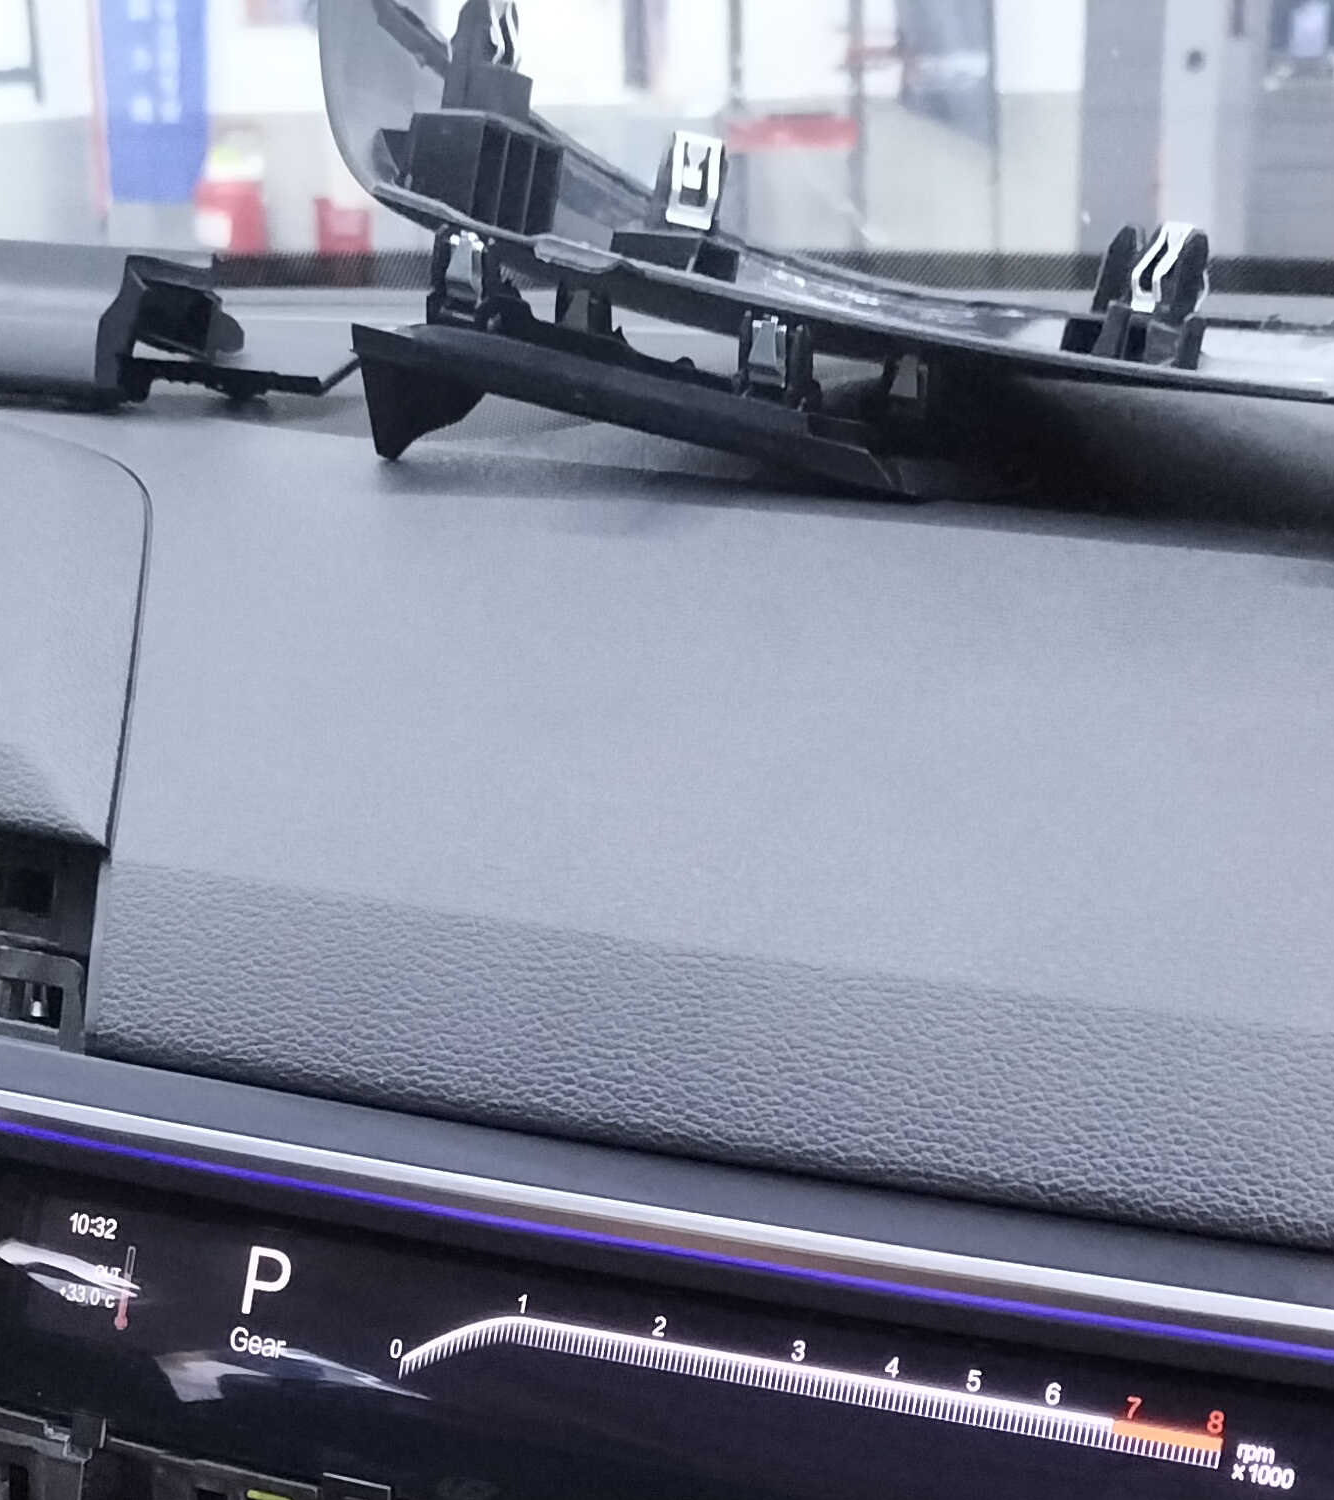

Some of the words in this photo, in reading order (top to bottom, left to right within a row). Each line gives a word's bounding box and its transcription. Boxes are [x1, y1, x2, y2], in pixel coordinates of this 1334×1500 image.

[69, 1212, 117, 1240] 10:32
[241, 1245, 292, 1315] P
[230, 1326, 287, 1359] Gear
[389, 1338, 403, 1359] 0
[518, 1294, 527, 1314] 1
[652, 1315, 667, 1338] 2
[791, 1340, 806, 1362] 3
[884, 1356, 900, 1379] 4
[966, 1369, 983, 1392] 5
[1045, 1382, 1062, 1406] 6
[1127, 1396, 1143, 1420] 7
[1207, 1410, 1225, 1434] 8
[1236, 1442, 1276, 1465] rpm
[1248, 1463, 1296, 1490] 1000
